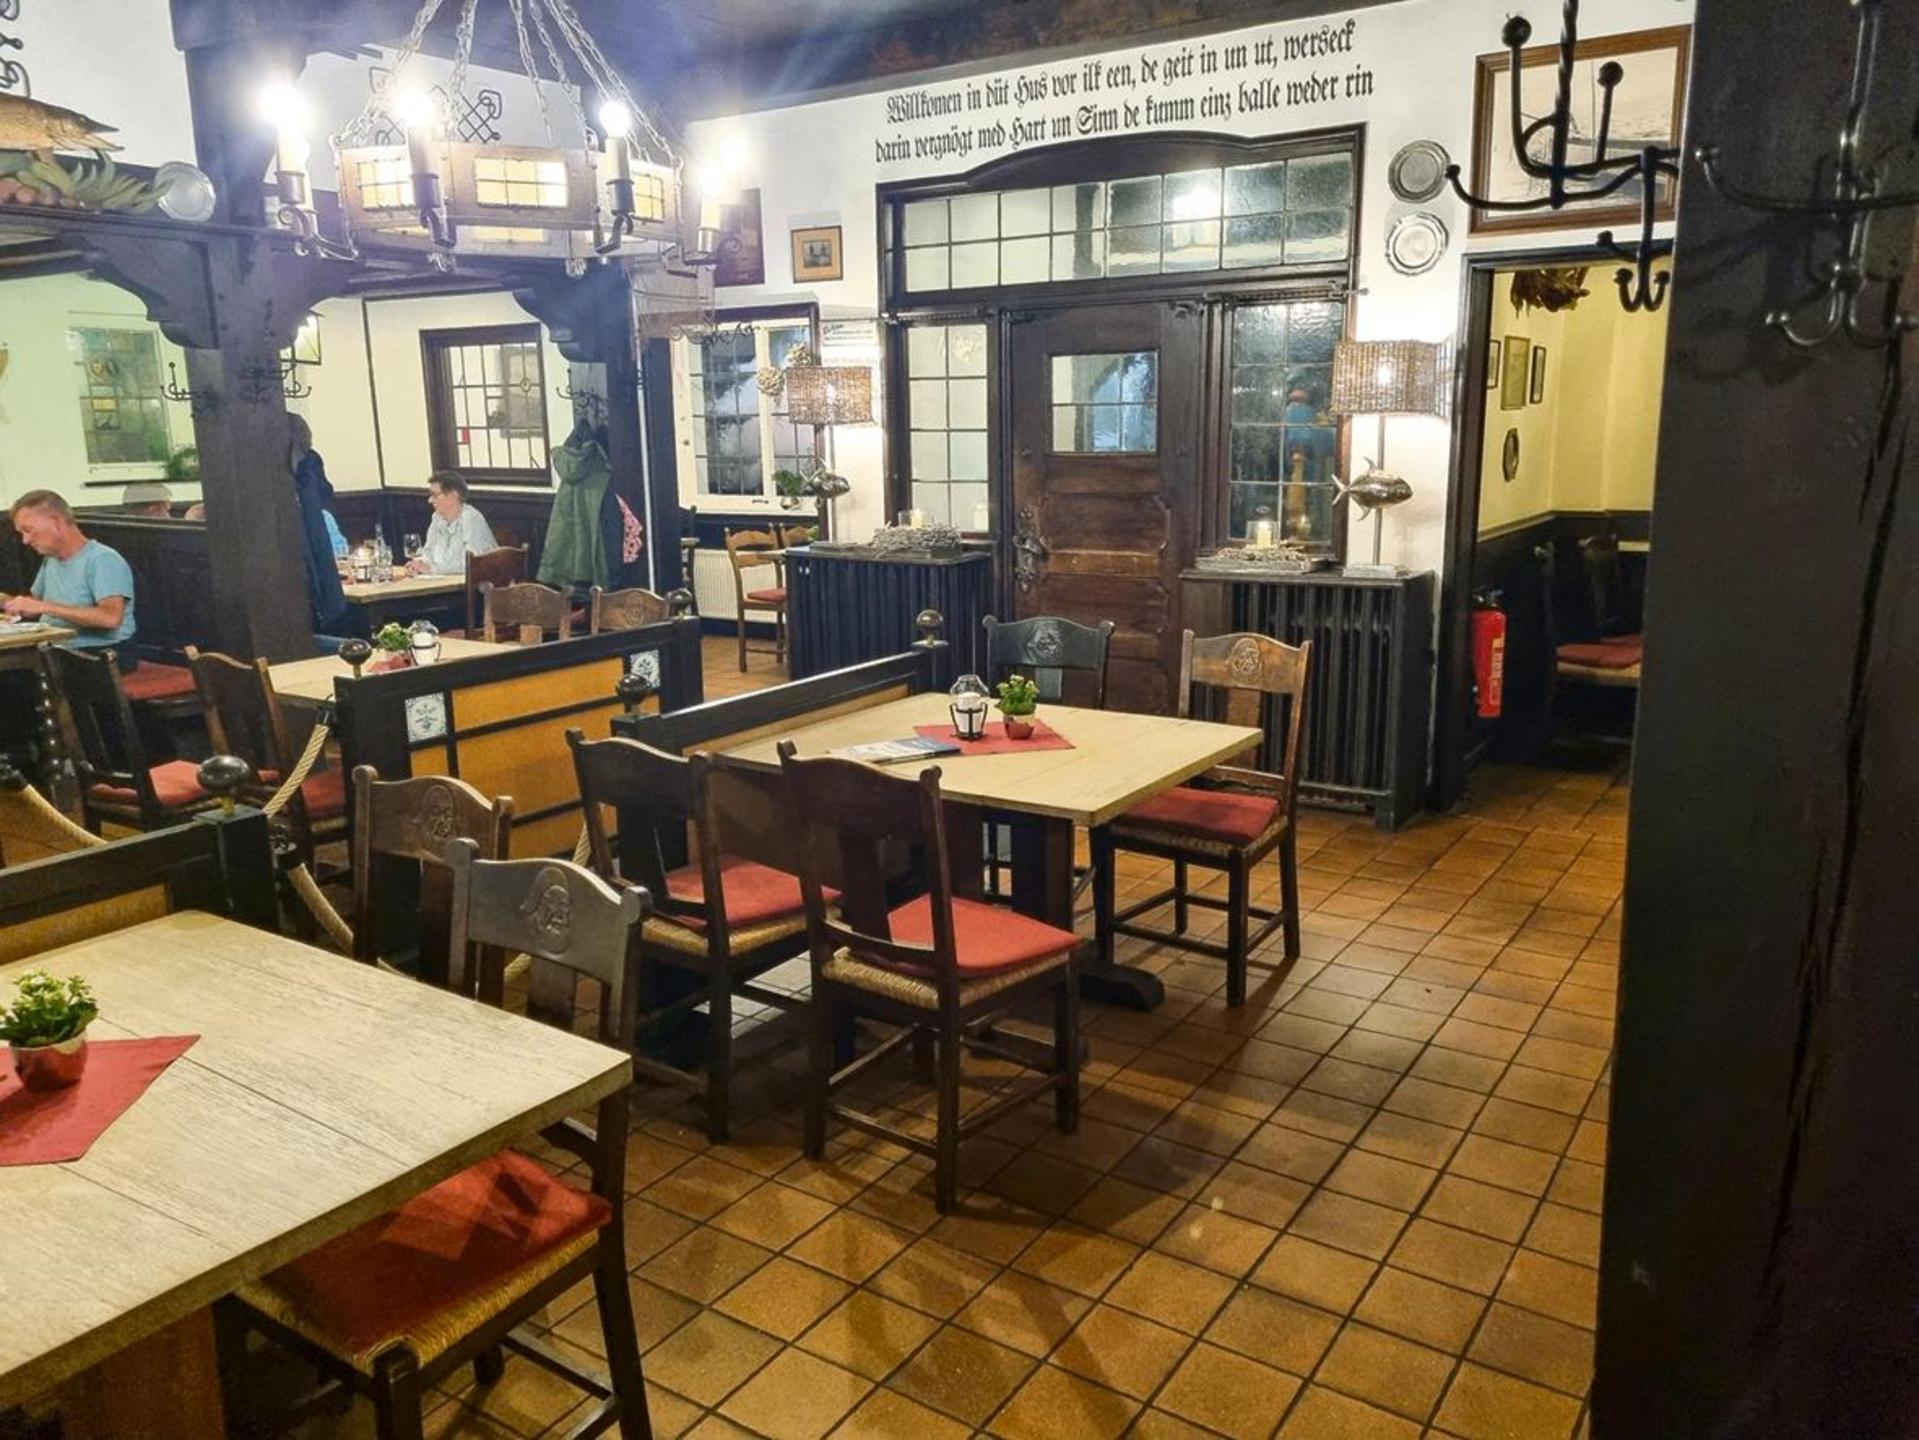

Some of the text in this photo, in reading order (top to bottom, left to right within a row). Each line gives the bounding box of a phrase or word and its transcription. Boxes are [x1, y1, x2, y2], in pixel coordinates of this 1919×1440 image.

[967, 83, 982, 111] in
[987, 78, 1009, 108] düt
[1014, 71, 1048, 109] Hus
[1052, 71, 1077, 97] vor
[1083, 60, 1102, 92] ilk
[1141, 53, 1158, 83] de
[1163, 47, 1194, 87] geit
[1201, 44, 1217, 74] in
[1224, 44, 1247, 70] un
[1254, 35, 1278, 68] ut,
[1009, 114, 1047, 150] Hart
[1052, 114, 1071, 139] un
[1124, 99, 1140, 128] de
[1287, 71, 1339, 106] weder
